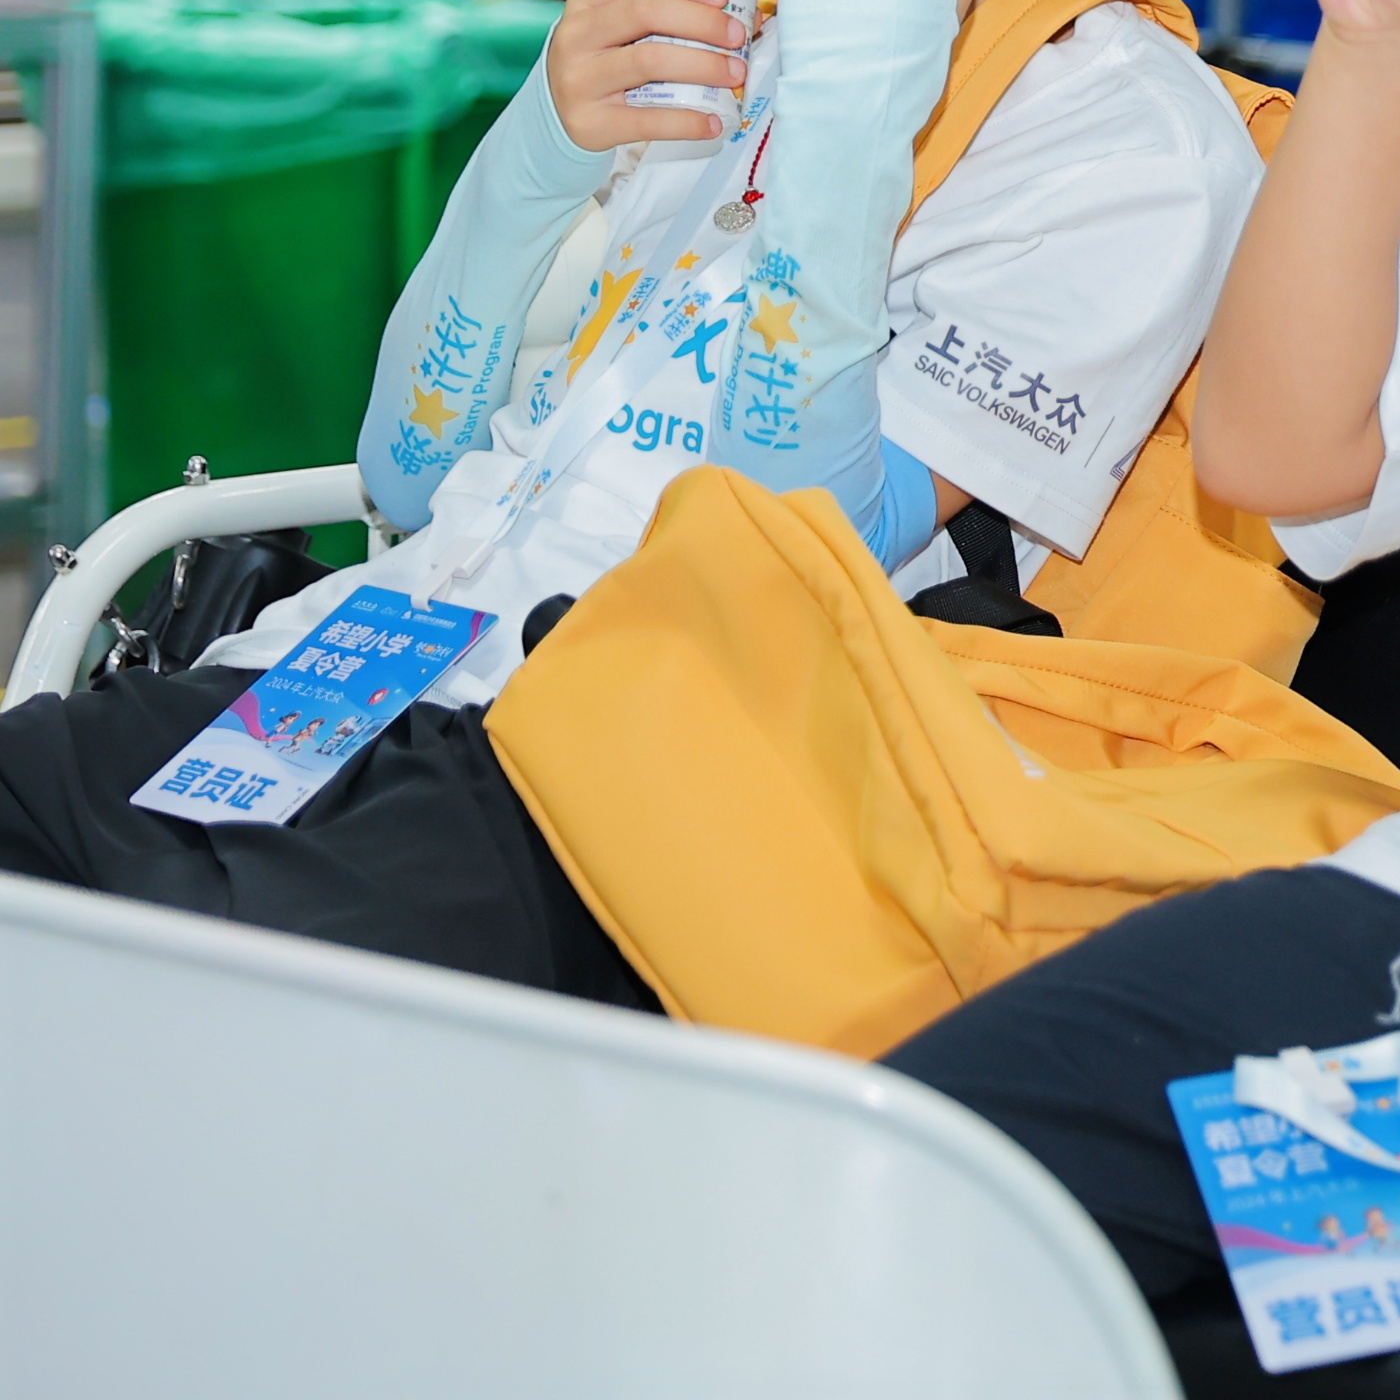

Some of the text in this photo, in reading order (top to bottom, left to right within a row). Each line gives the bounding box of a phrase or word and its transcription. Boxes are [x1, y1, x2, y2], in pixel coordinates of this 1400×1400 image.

[454, 325, 507, 446] Starry Program
[914, 354, 1071, 456] SAIC VOLKSWAGEN
[924, 324, 1086, 435] 上汽大众
[287, 646, 367, 682] 夏令营
[317, 619, 416, 658] 希望小学
[158, 757, 280, 811] 营员证
